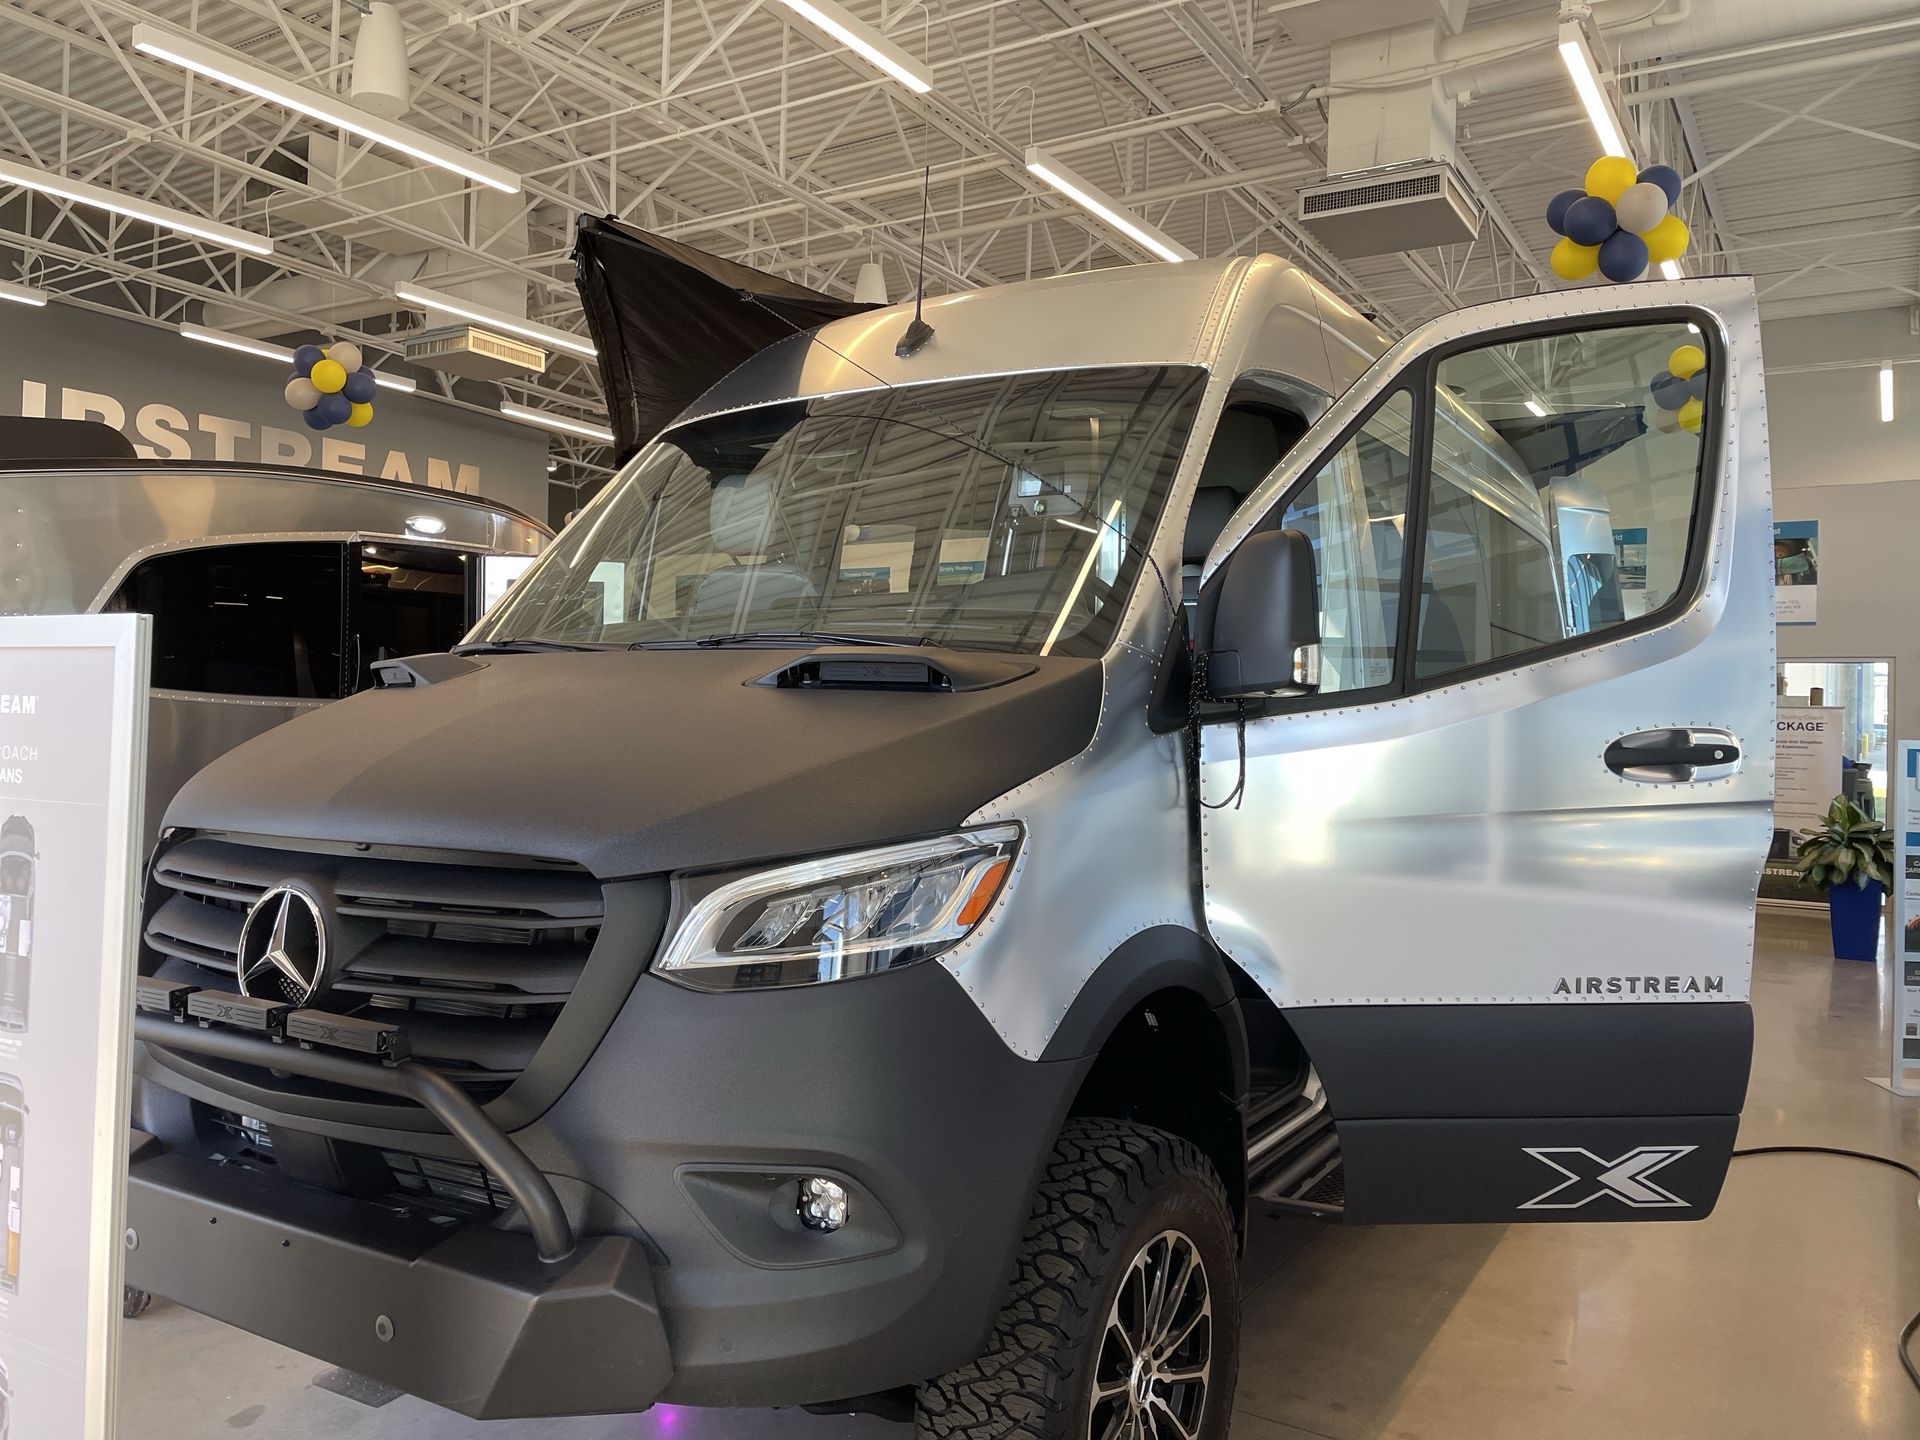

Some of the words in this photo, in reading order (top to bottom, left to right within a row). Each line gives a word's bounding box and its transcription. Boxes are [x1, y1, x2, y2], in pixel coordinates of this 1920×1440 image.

[1776, 721, 1824, 731] CKAGE
[0, 744, 38, 761] OACH
[1763, 867, 1803, 877] STREA
[1553, 976, 1724, 995] AIRSTREAM
[1516, 1145, 1700, 1209] X
